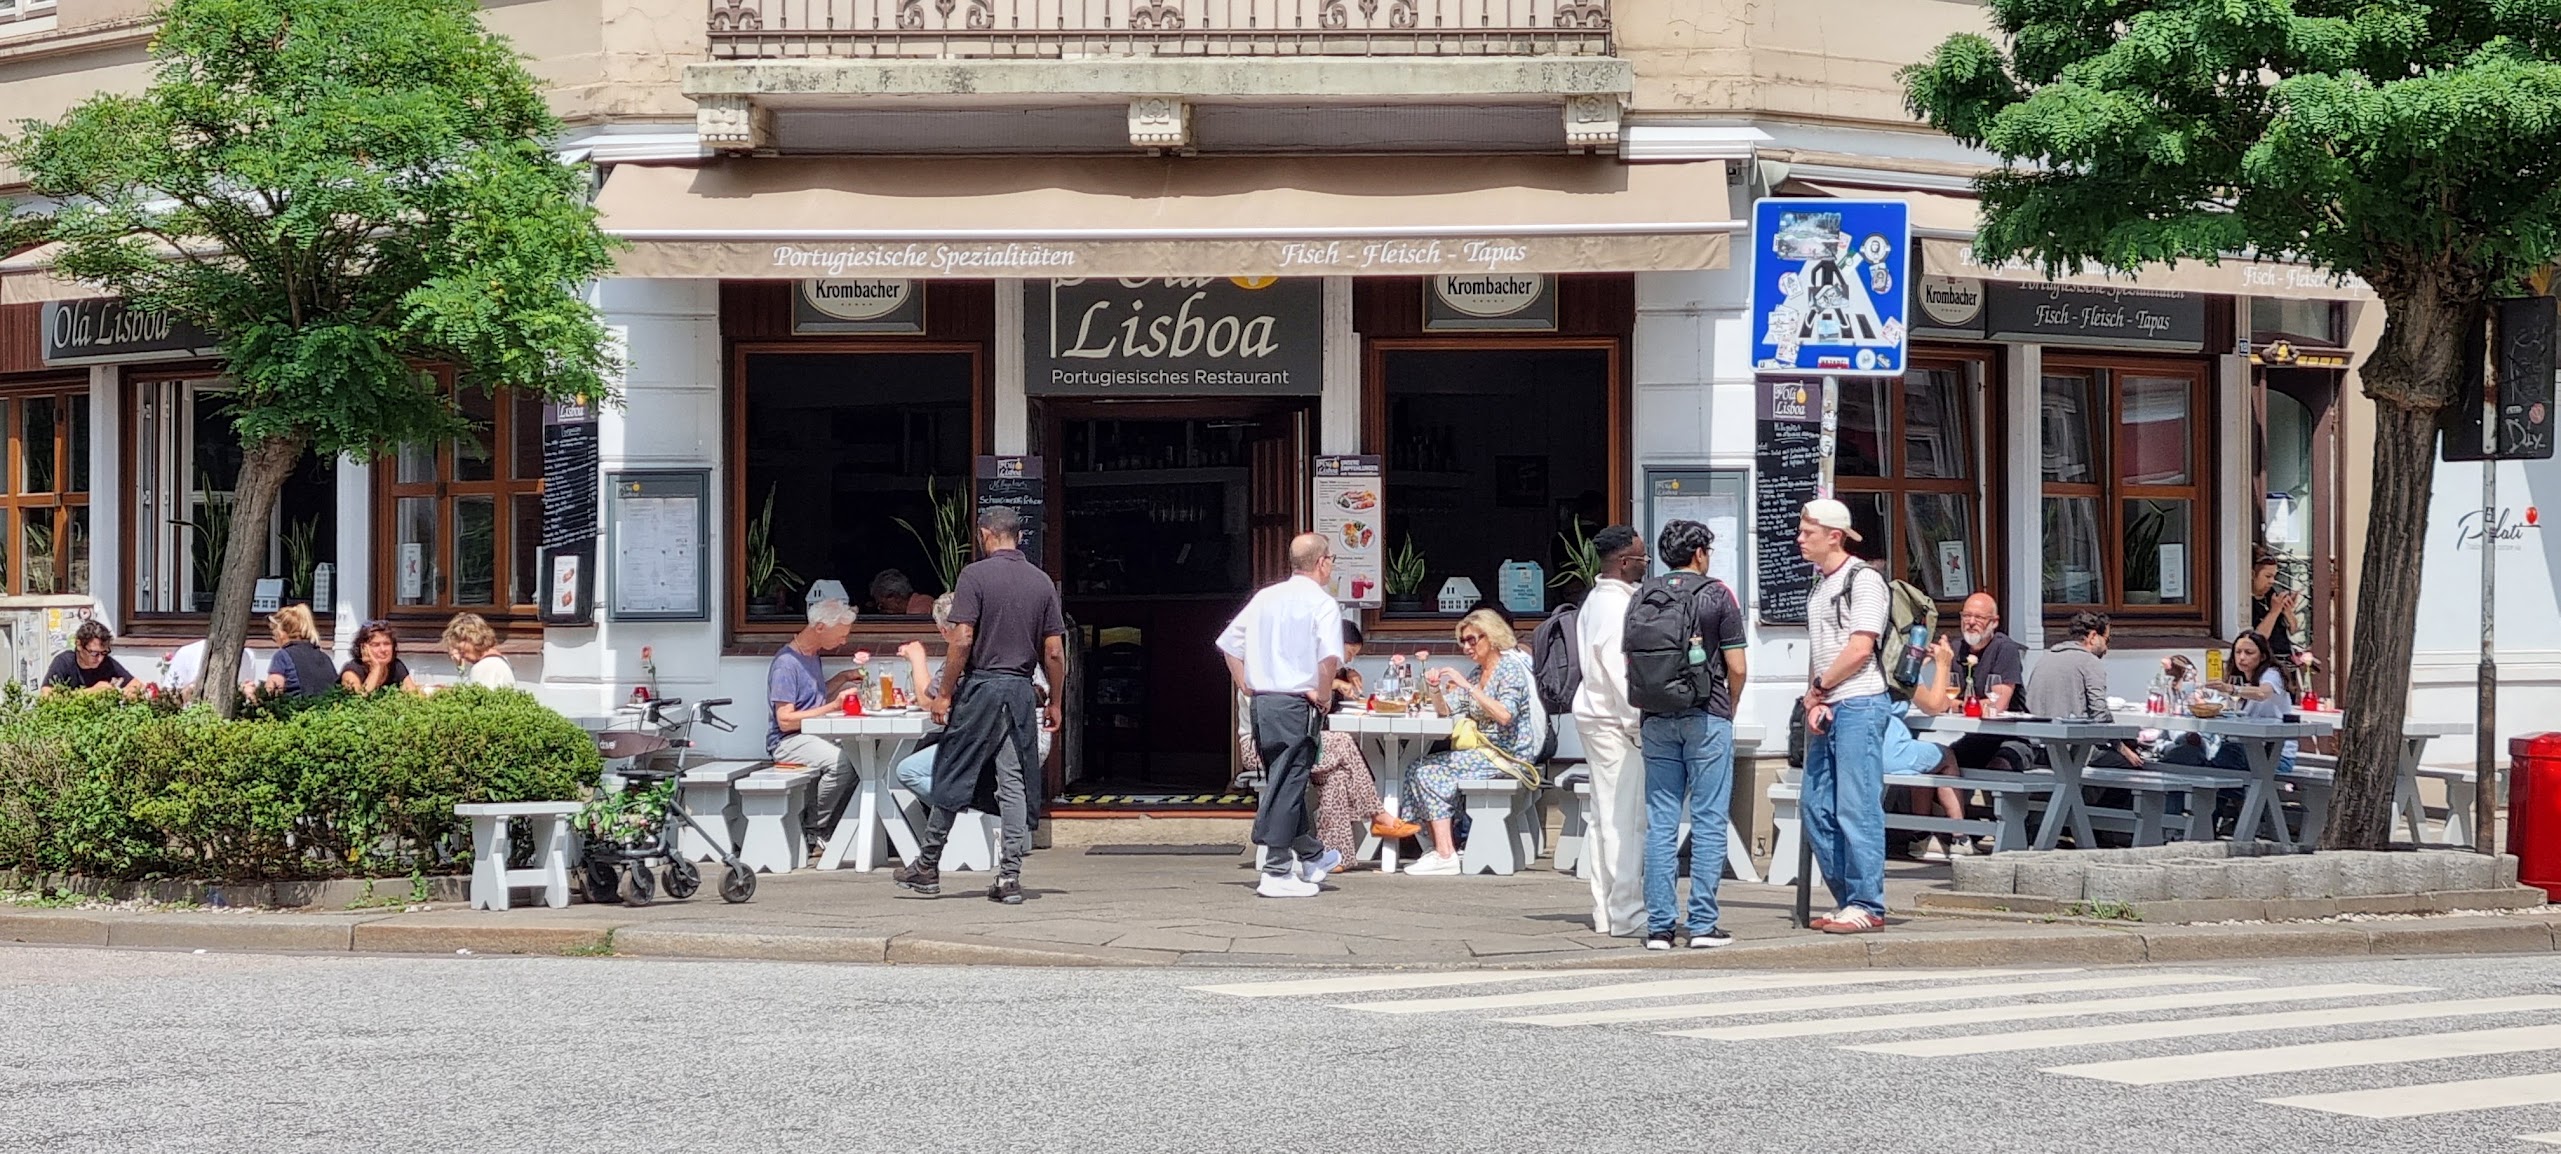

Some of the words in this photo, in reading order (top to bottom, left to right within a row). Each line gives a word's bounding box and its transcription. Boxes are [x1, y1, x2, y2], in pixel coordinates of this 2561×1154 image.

[773, 243, 927, 275] Portugiesische
[930, 243, 1076, 275] Spezialitäten
[1279, 241, 1340, 267] Fisch
[1360, 240, 1441, 268] Fleisch
[1463, 240, 1527, 269] Tapas
[1447, 275, 1533, 295] Krombacher
[2242, 265, 2275, 287] Fisch
[815, 279, 901, 298] Krombacher
[1926, 284, 1978, 306] Krombacher
[53, 299, 92, 348] Olá
[1061, 291, 1280, 359] Lisboa
[2034, 303, 2069, 327] Fisch
[2079, 305, 2124, 329] Fleisch
[2135, 310, 2170, 337] Tapas
[1051, 369, 1189, 387] Portugiesisches
[1194, 369, 1290, 385] Restaurant
[1775, 401, 1806, 415] Lisboa
